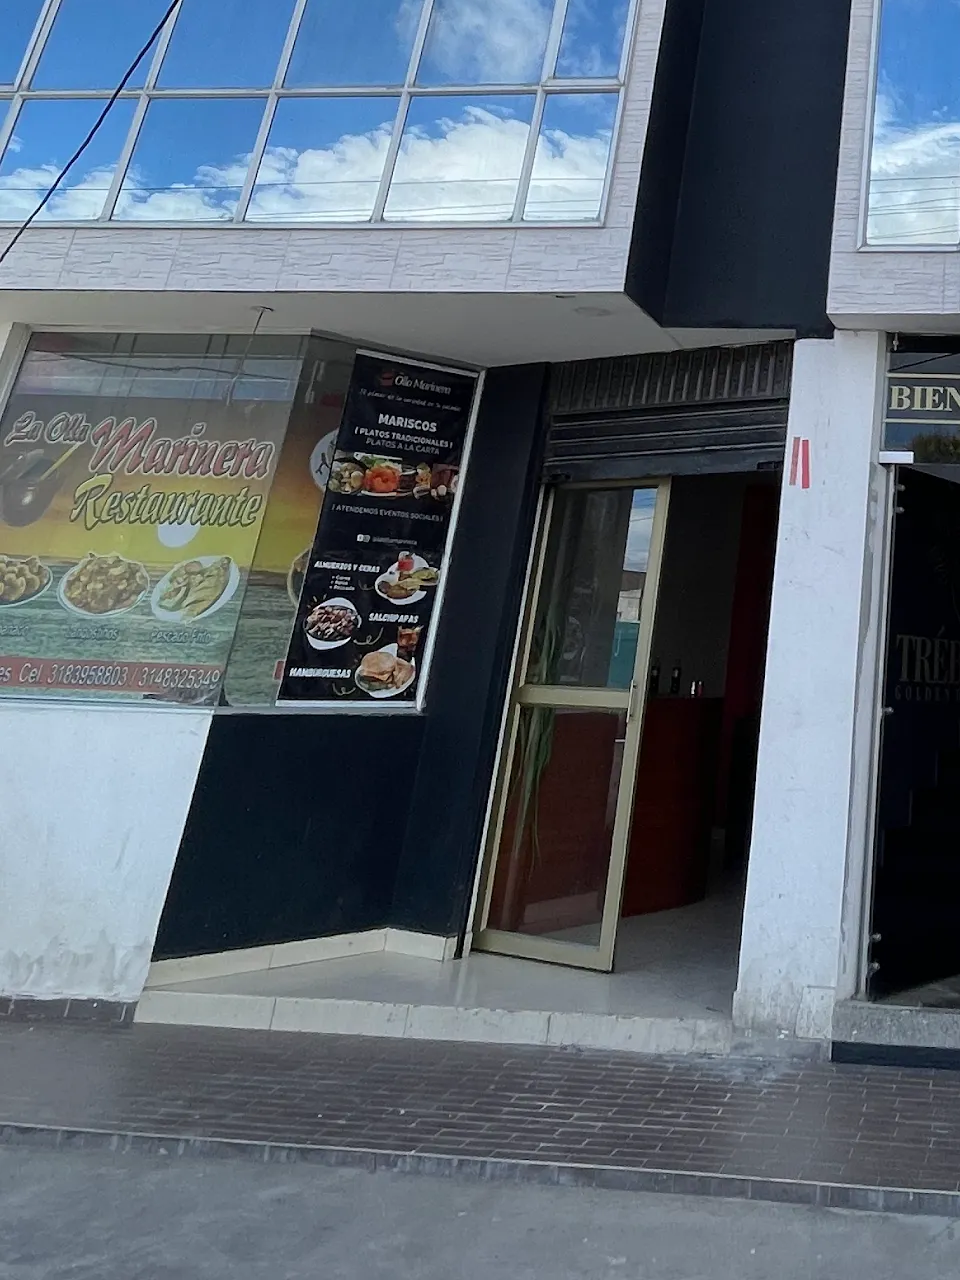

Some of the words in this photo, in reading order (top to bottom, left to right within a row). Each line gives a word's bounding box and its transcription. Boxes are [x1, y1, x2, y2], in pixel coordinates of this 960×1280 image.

[378, 412, 438, 433] MARISCOS
[4, 410, 44, 447] La
[44, 411, 94, 445] Olla
[89, 415, 277, 480] Marinera
[365, 437, 396, 449] PLATOS
[397, 442, 403, 450] A
[404, 443, 414, 451] LA
[415, 444, 440, 456] CARTA
[69, 472, 263, 532] Restaurante
[368, 612, 420, 624] SALCHIPAPAS
[47, 663, 129, 686] 3183958803
[138, 666, 221, 690] 3148325349
